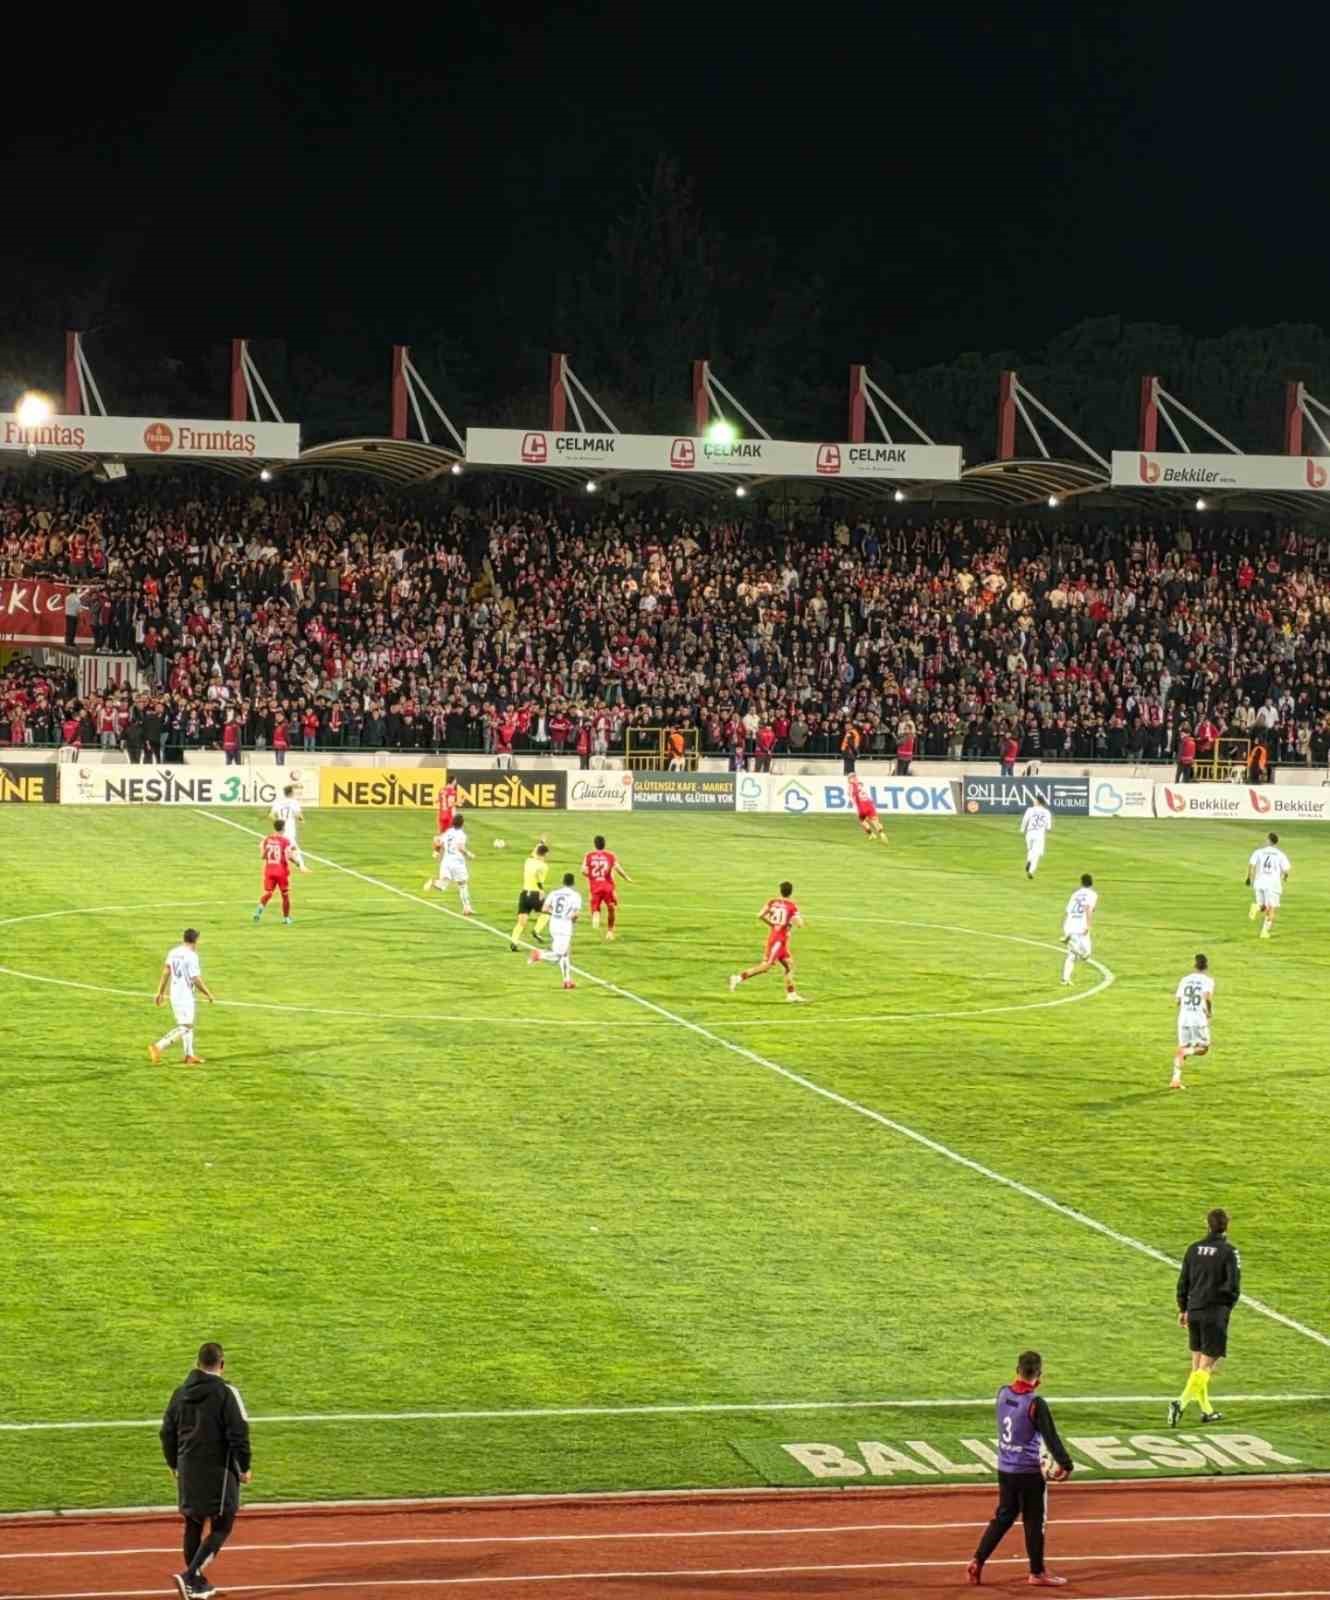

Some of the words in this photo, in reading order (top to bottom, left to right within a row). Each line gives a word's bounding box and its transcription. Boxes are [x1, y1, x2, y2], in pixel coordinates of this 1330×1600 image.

[555, 437, 615, 453] ÇELMAK
[703, 443, 761, 459] ÇELMAK
[848, 448, 906, 464] ÇELMAK
[1163, 467, 1219, 482] Bekkiler
[703, 782, 733, 793] MARKET
[718, 794, 734, 803] YOK
[824, 785, 953, 810] BLTOK
[1190, 799, 1240, 810] Bekkiler
[1274, 800, 1325, 812] Bekkiler
[555, 896, 566, 914] 6
[1183, 985, 1202, 1006] 96
[1002, 1416, 1012, 1442] 3
[780, 1433, 1303, 1478] BALIESİR
